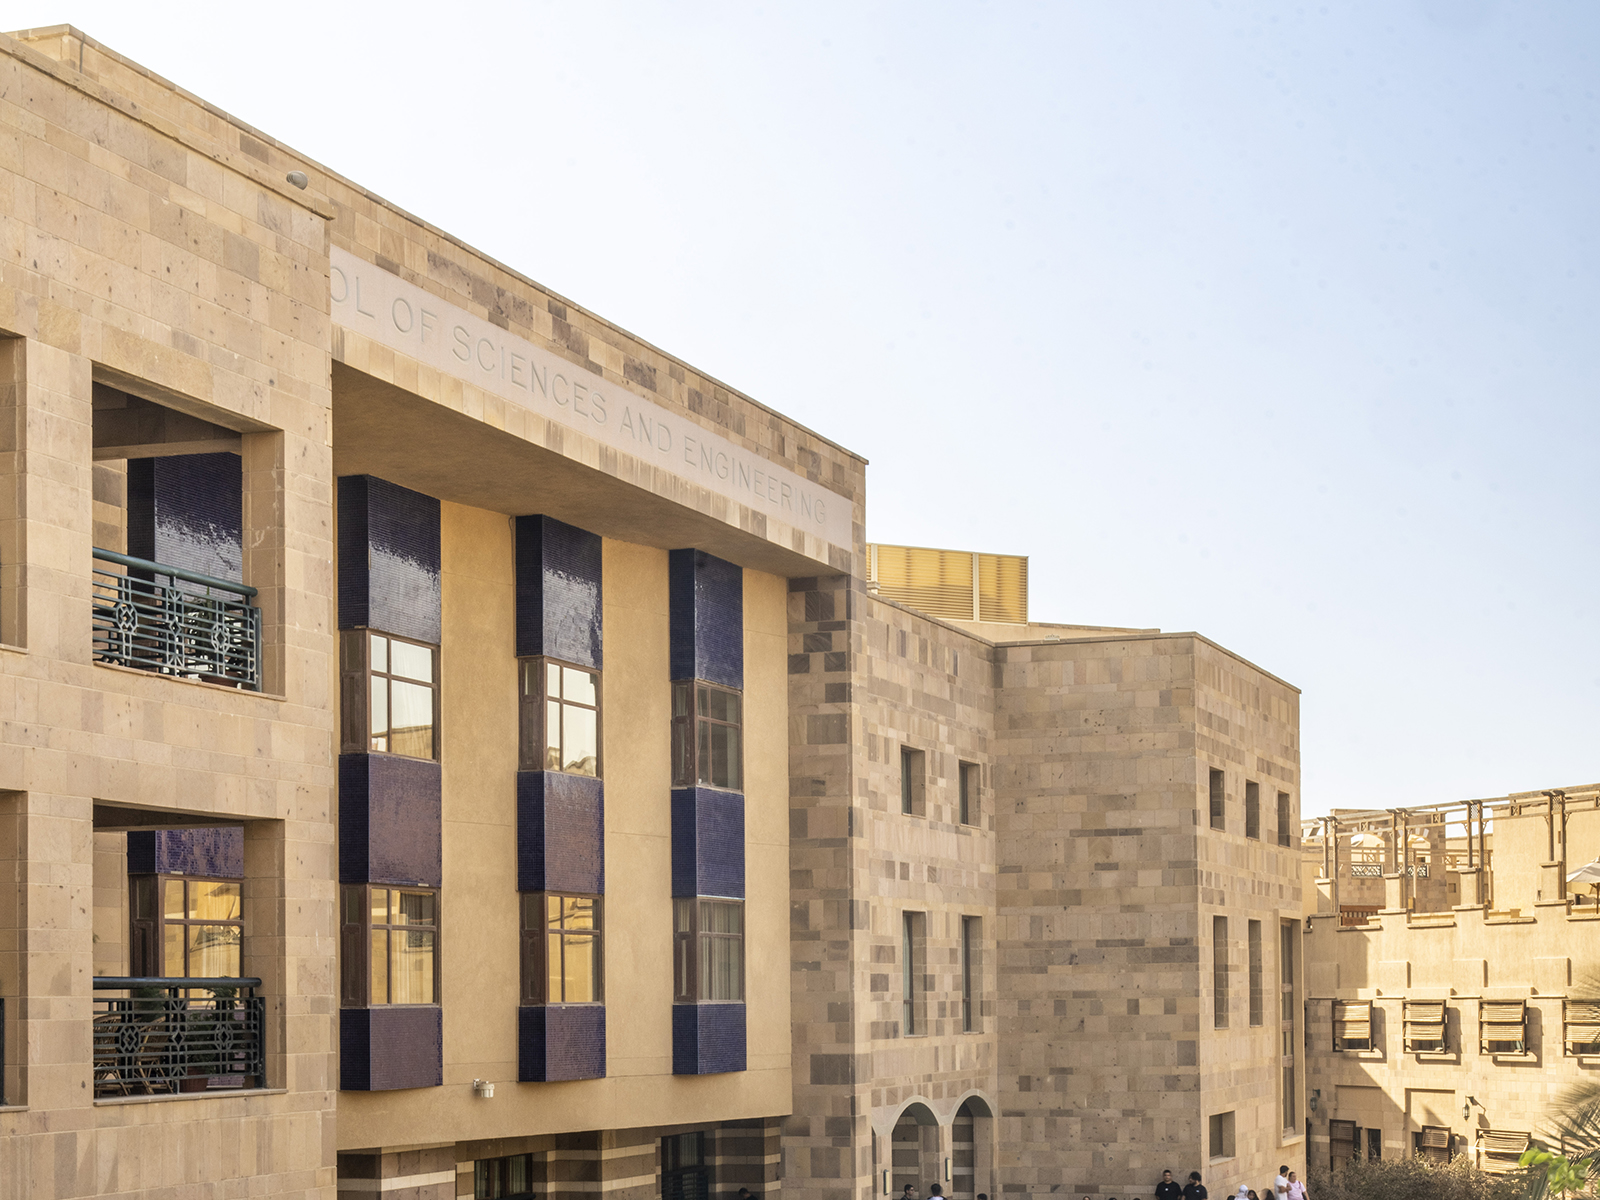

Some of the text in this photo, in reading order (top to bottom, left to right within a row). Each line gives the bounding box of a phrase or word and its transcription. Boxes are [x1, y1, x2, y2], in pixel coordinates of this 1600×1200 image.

[391, 297, 438, 343] OF
[451, 325, 608, 426] SCIENCES
[619, 406, 673, 454] AND
[683, 434, 827, 525] ENGINEERING
